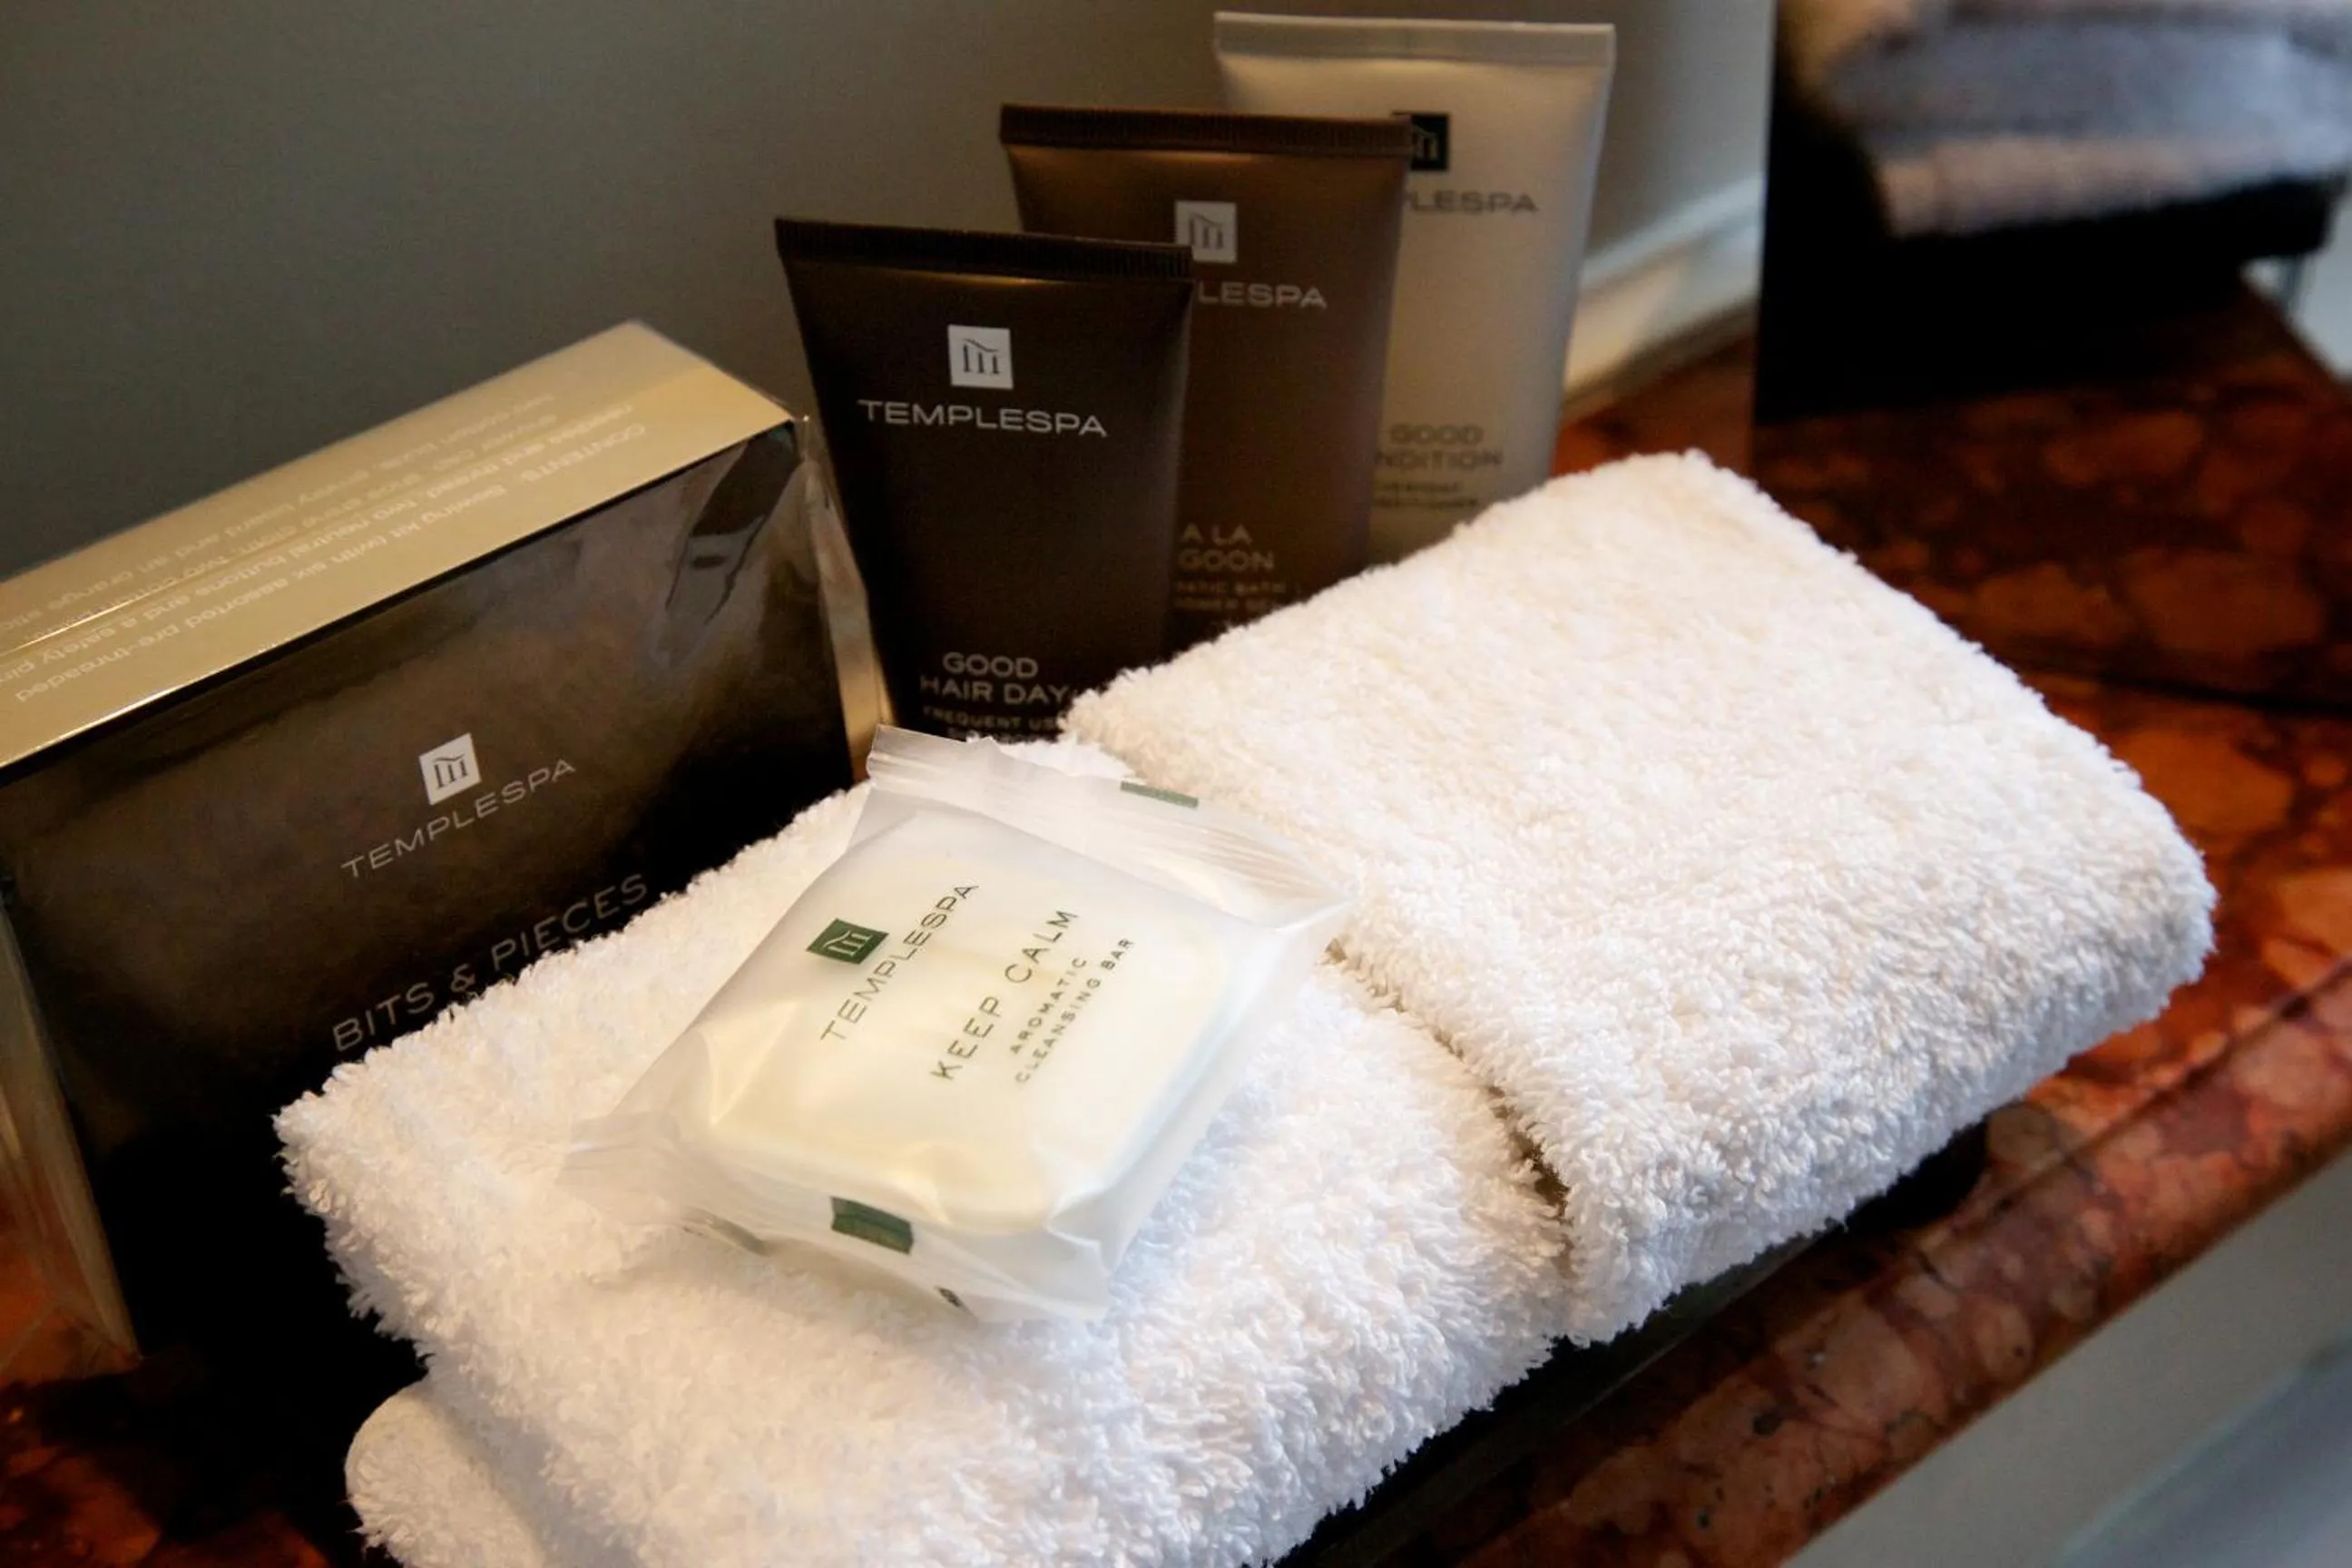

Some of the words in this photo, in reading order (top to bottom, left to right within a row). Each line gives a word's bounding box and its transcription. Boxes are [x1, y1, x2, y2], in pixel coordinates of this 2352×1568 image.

[1405, 190, 1539, 215] LESPA
[1197, 281, 1328, 309] LESPA
[856, 399, 1108, 437] TEMPLESPA
[1389, 423, 1485, 446] GOOD
[1374, 448, 1504, 471] NDITION
[372, 499, 416, 520] two
[289, 518, 370, 556] neutral
[1181, 522, 1204, 544] A
[1211, 522, 1253, 546] LA
[195, 554, 285, 598] buttons
[1178, 548, 1275, 572] GOON
[142, 595, 190, 621] and
[185, 577, 288, 627] assorted
[15, 623, 179, 703] pre-threaded
[39, 624, 115, 664] safety
[942, 651, 1039, 679] GOOD
[919, 675, 994, 703] HAIR
[1003, 681, 1070, 706] DAY
[340, 759, 576, 878] TEMPLESPA
[332, 981, 435, 1053] BITS
[450, 963, 477, 992] &
[490, 873, 648, 972] PIECES
[819, 882, 981, 1042] TEMPLESPA
[930, 995, 1003, 1081] KEEP
[1004, 908, 1079, 985] CALM
[1010, 956, 1088, 1056] AROMATIC
[1014, 977, 1101, 1084] CLEANSING
[1100, 937, 1135, 971] BAR
